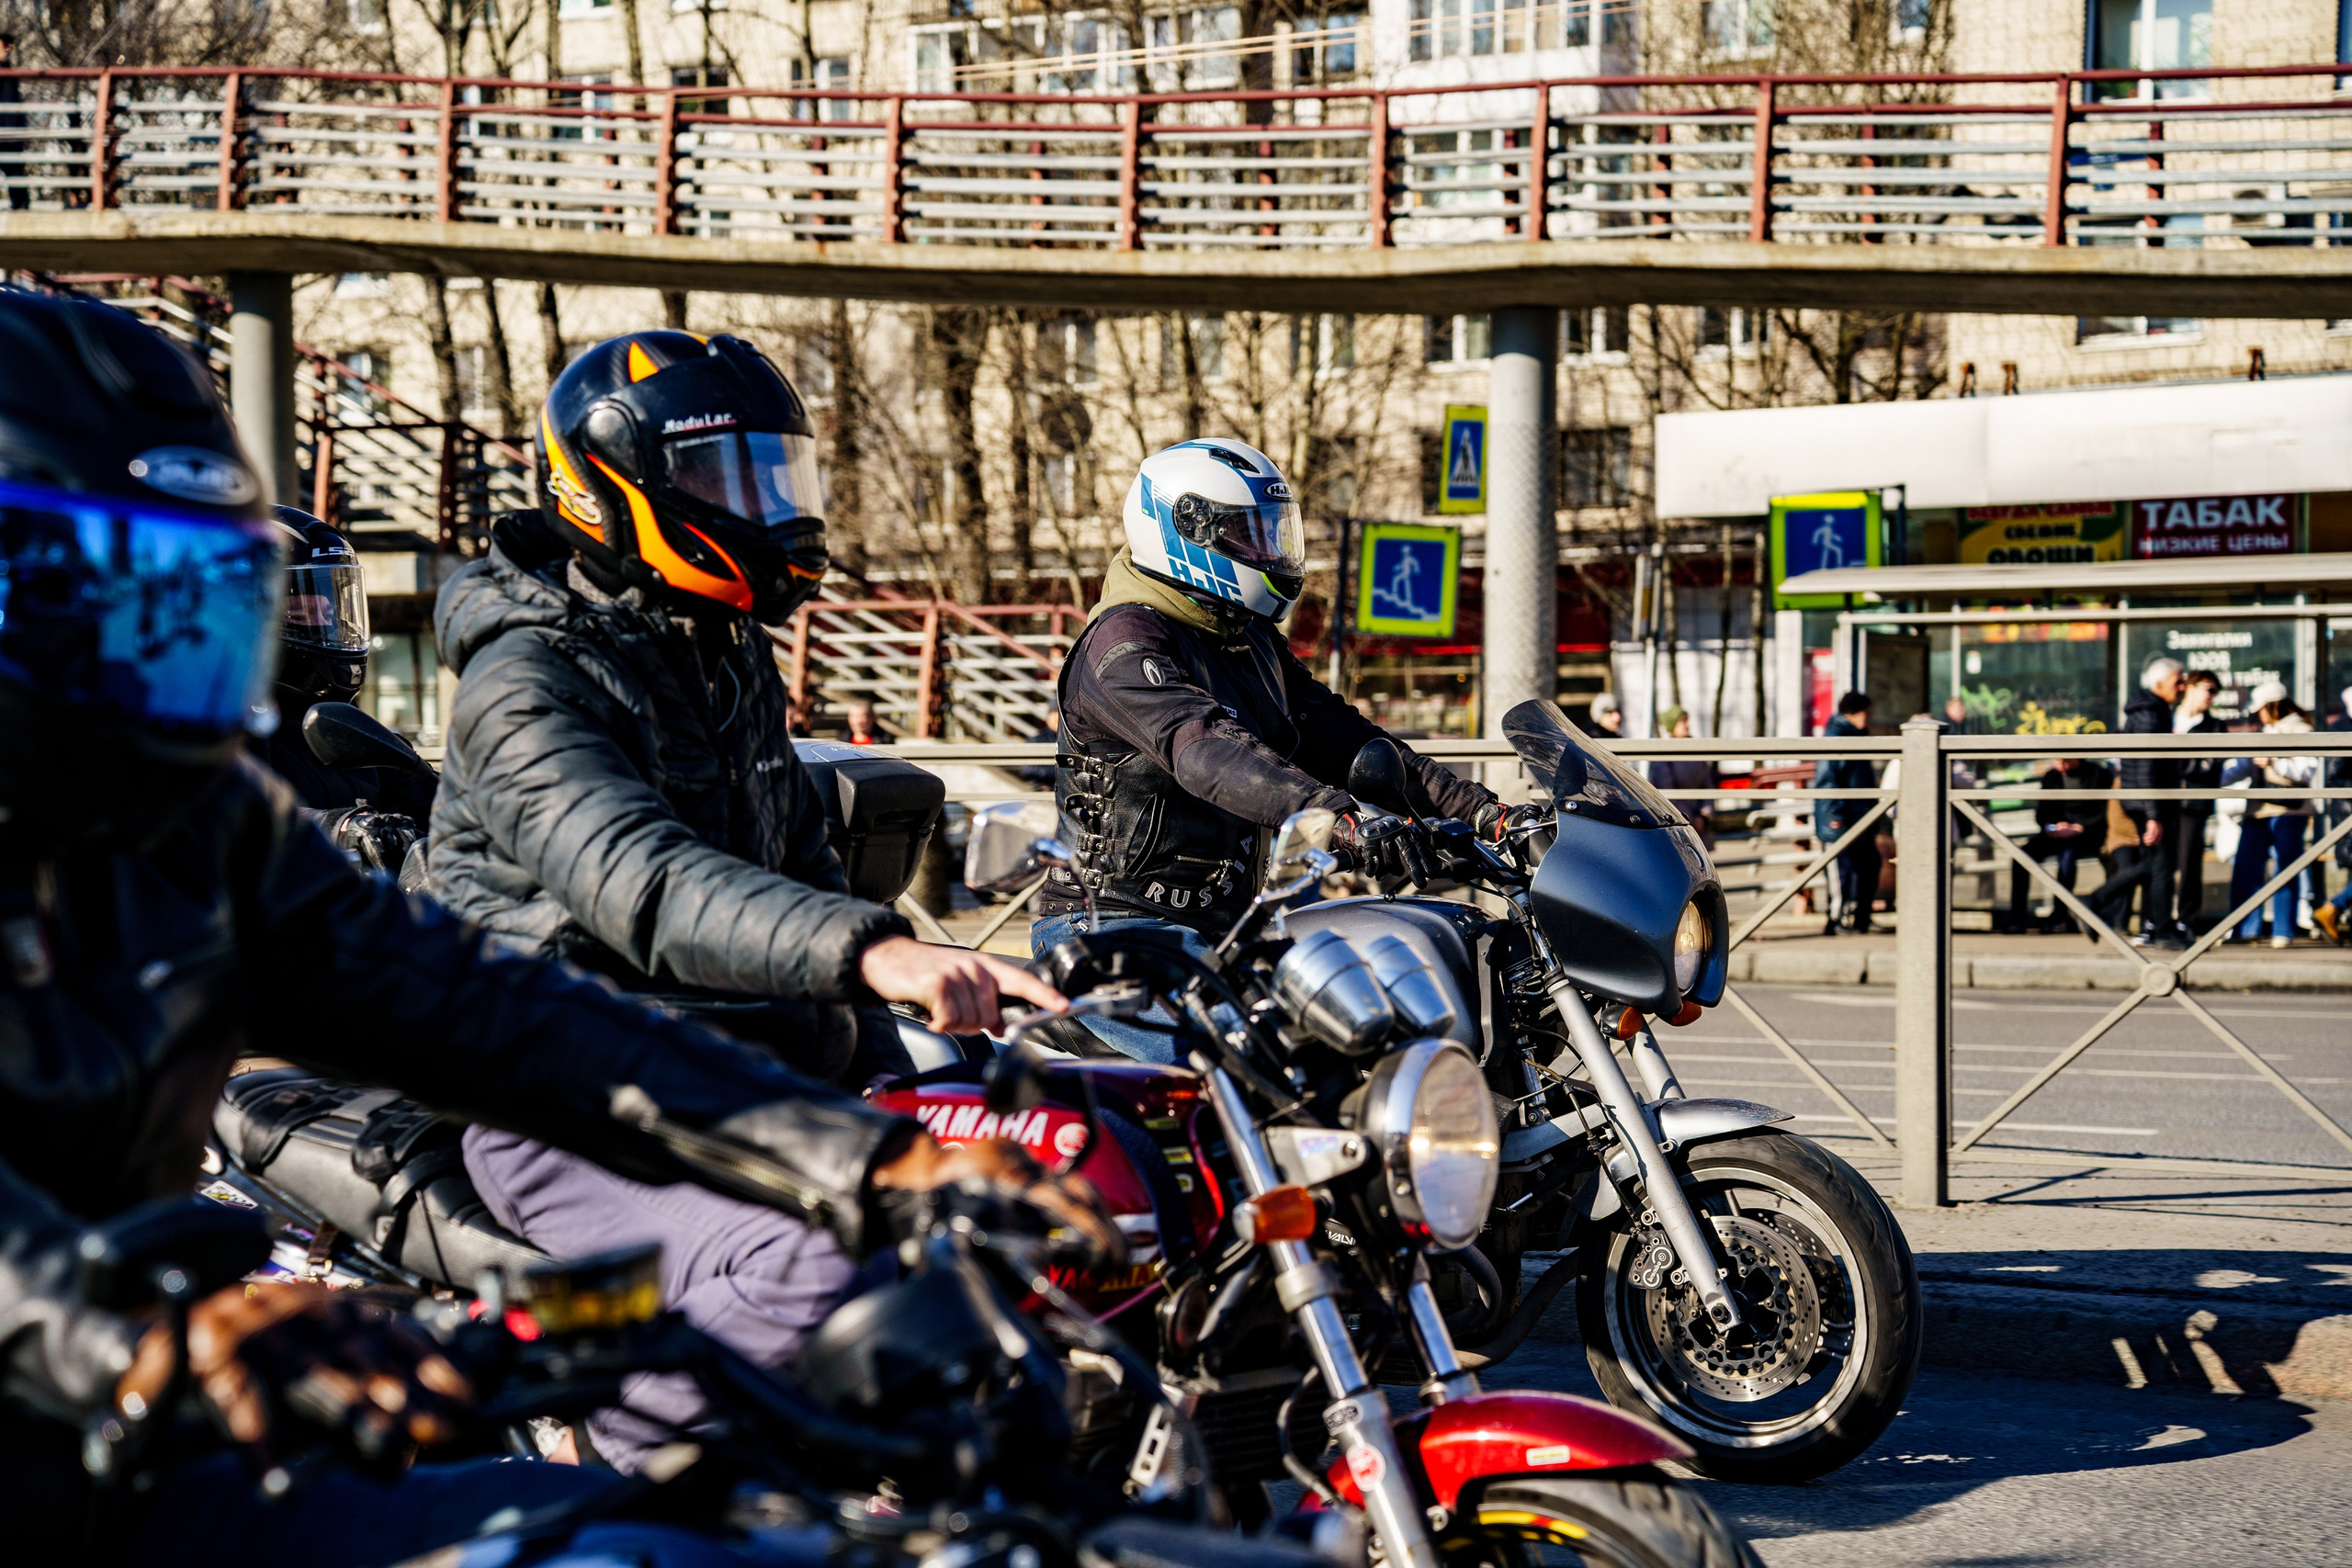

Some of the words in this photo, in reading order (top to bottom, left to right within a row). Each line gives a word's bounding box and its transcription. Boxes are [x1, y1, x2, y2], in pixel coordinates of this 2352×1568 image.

[663, 412, 734, 433] Modular
[2141, 496, 2288, 530] ТАБАК
[2139, 536, 2222, 553] НИЗКИЕ
[2227, 533, 2290, 552] ЦЕНЫ
[1168, 558, 1246, 607] HJC
[1145, 835, 1254, 908] RUSSIA
[916, 1104, 1049, 1147] YAMAHA
[1647, 1261, 1662, 1283] brembo
